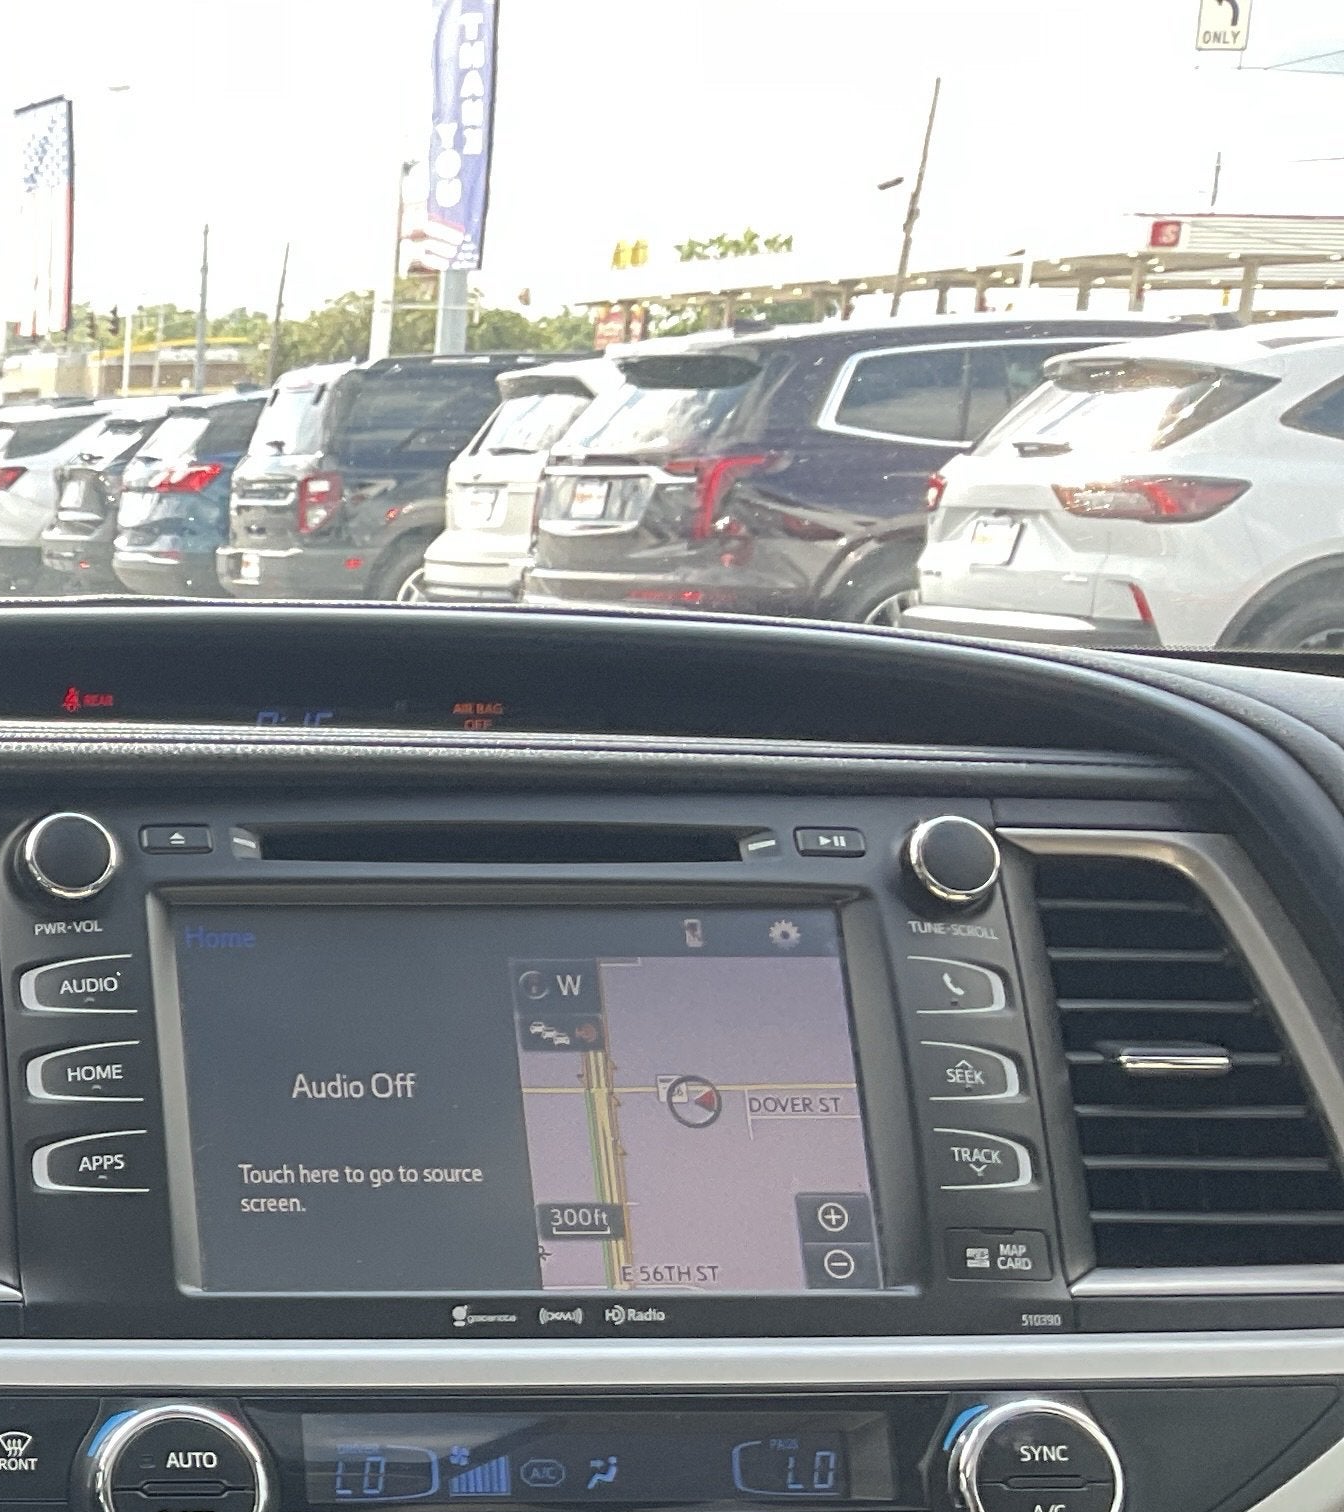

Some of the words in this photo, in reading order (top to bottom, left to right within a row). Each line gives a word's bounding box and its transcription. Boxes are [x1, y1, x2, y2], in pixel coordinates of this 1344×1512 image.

[1202, 30, 1241, 45] ONLY
[184, 927, 256, 948] Home
[60, 975, 118, 995] AUDIO
[555, 974, 582, 996] W
[67, 1063, 124, 1082] HOME
[945, 1068, 985, 1085] SEEK
[291, 1072, 365, 1100] Audio
[370, 1072, 416, 1099] Off
[748, 1096, 813, 1113] DOVER
[818, 1096, 841, 1113] ST
[78, 1153, 125, 1172] APPS
[950, 1147, 1002, 1164] TRACK
[238, 1163, 295, 1184] Touch
[299, 1164, 339, 1184] here
[344, 1165, 365, 1183] to
[369, 1167, 394, 1188] go
[399, 1165, 419, 1183] to
[423, 1168, 484, 1183] source
[240, 1197, 307, 1213] screen.
[550, 1208, 609, 1227] 300ft
[999, 1243, 1027, 1257] MAP
[997, 1256, 1032, 1270] CARD
[621, 1265, 634, 1282] E
[639, 1264, 692, 1283] 56TH
[696, 1265, 719, 1282] ST
[627, 1307, 666, 1322] Radio
[165, 1451, 218, 1470] AUTO
[1019, 1444, 1069, 1462] SYNC
